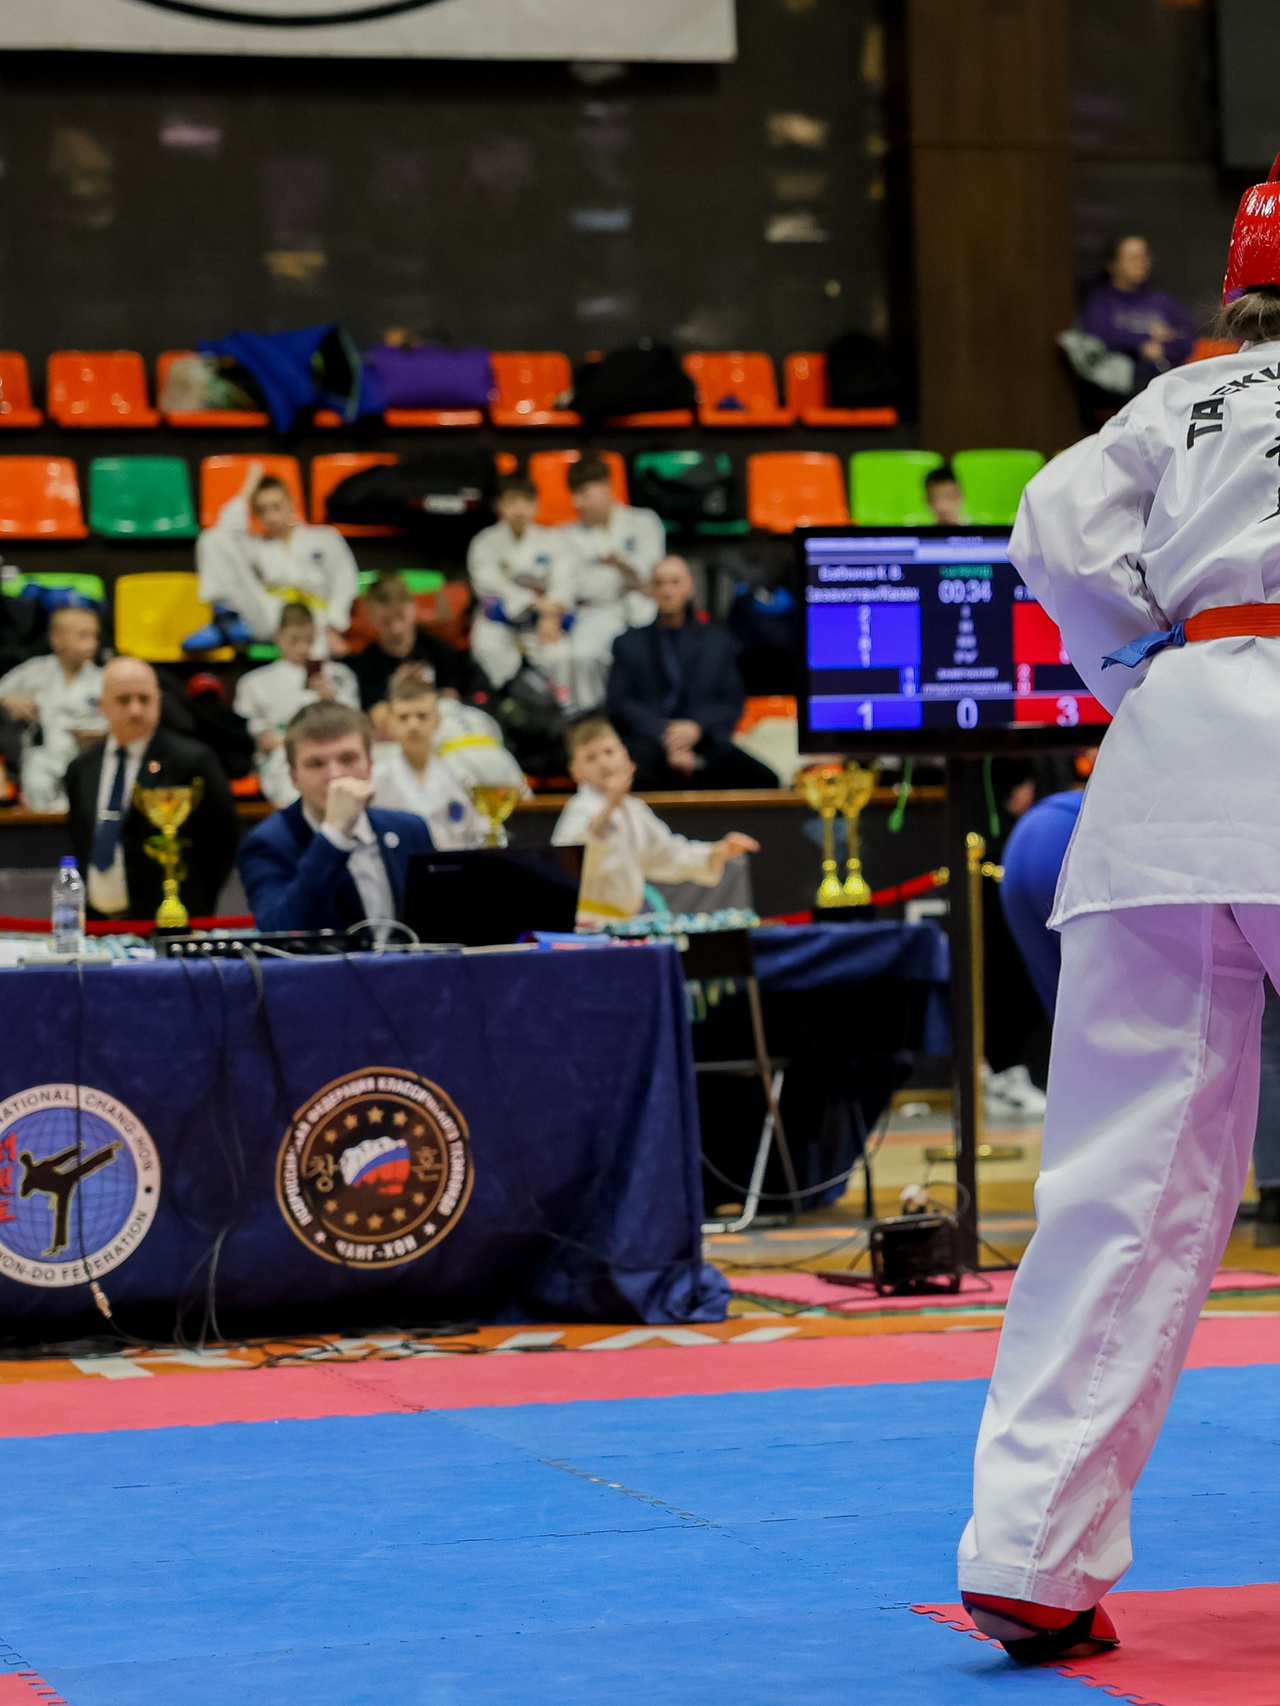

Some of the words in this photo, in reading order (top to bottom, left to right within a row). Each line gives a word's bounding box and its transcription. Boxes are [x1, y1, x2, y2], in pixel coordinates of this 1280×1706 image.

[857, 700, 873, 731] 1
[957, 698, 979, 730] 0
[1057, 696, 1080, 728] 3
[0, 1090, 72, 1122] ATIONAL
[0, 1253, 56, 1281] ON-DO
[62, 1210, 147, 1281] FEDERATION
[335, 1234, 418, 1261] ЧАНГ-ХОН
